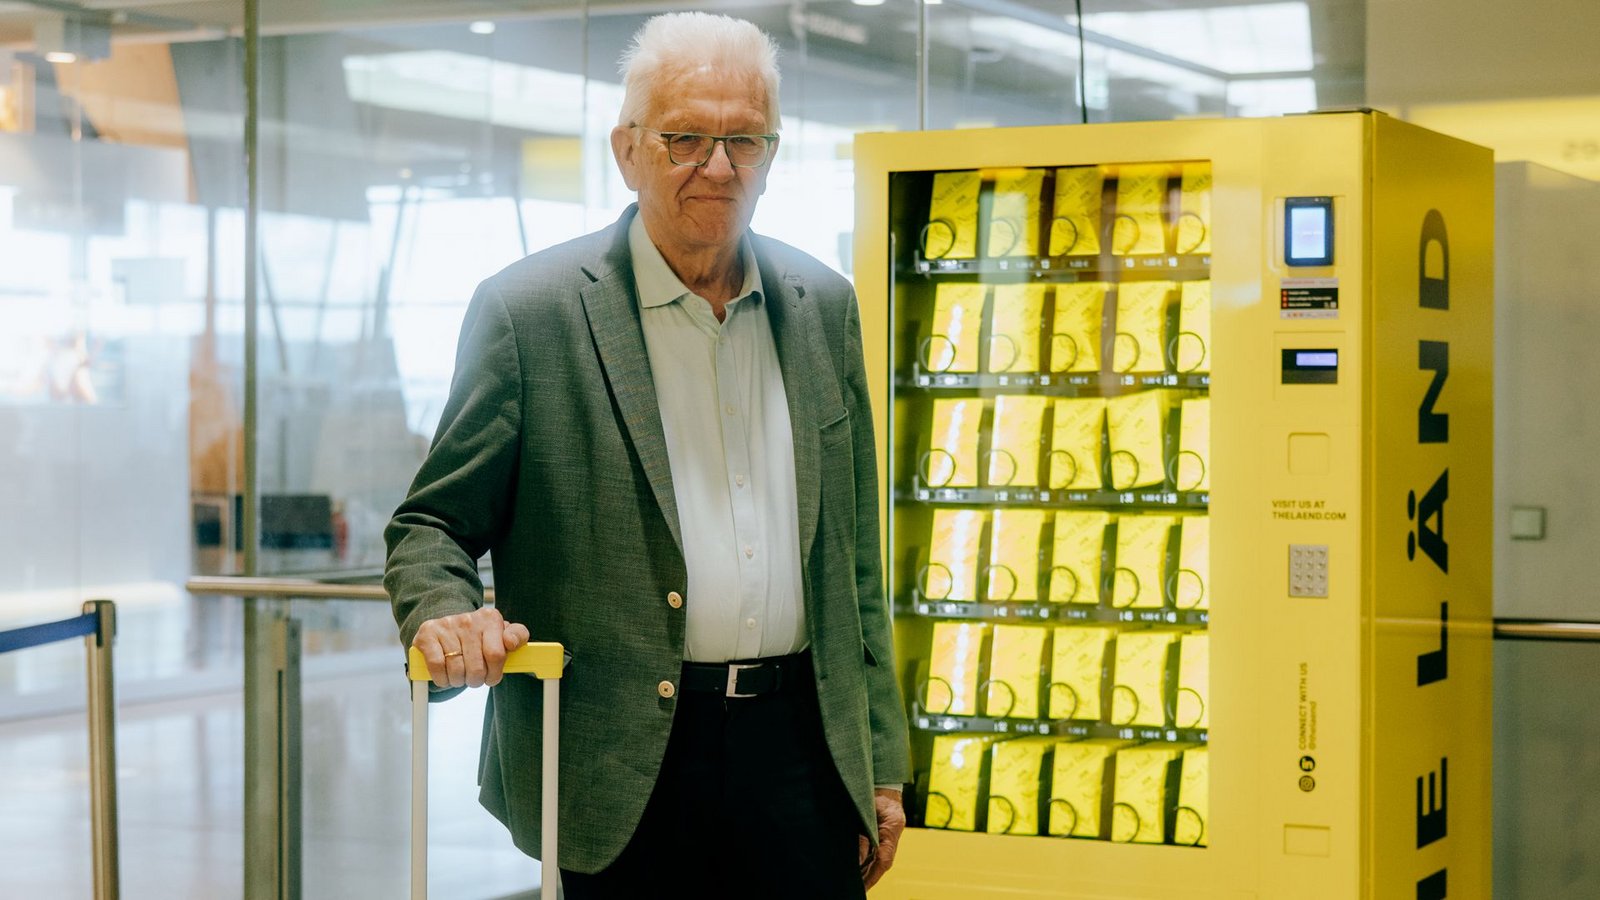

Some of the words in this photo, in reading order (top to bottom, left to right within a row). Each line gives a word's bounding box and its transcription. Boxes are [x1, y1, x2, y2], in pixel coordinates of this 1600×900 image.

[1406, 208, 1450, 688] LÄND
[1271, 500, 1296, 509] VISIT
[1298, 500, 1312, 509] US
[1313, 500, 1326, 509] AT
[1272, 511, 1347, 521] THELAEND.COM
[1299, 662, 1308, 676] US
[1299, 677, 1307, 703] WITH
[1298, 705, 1307, 751] CONNECT
